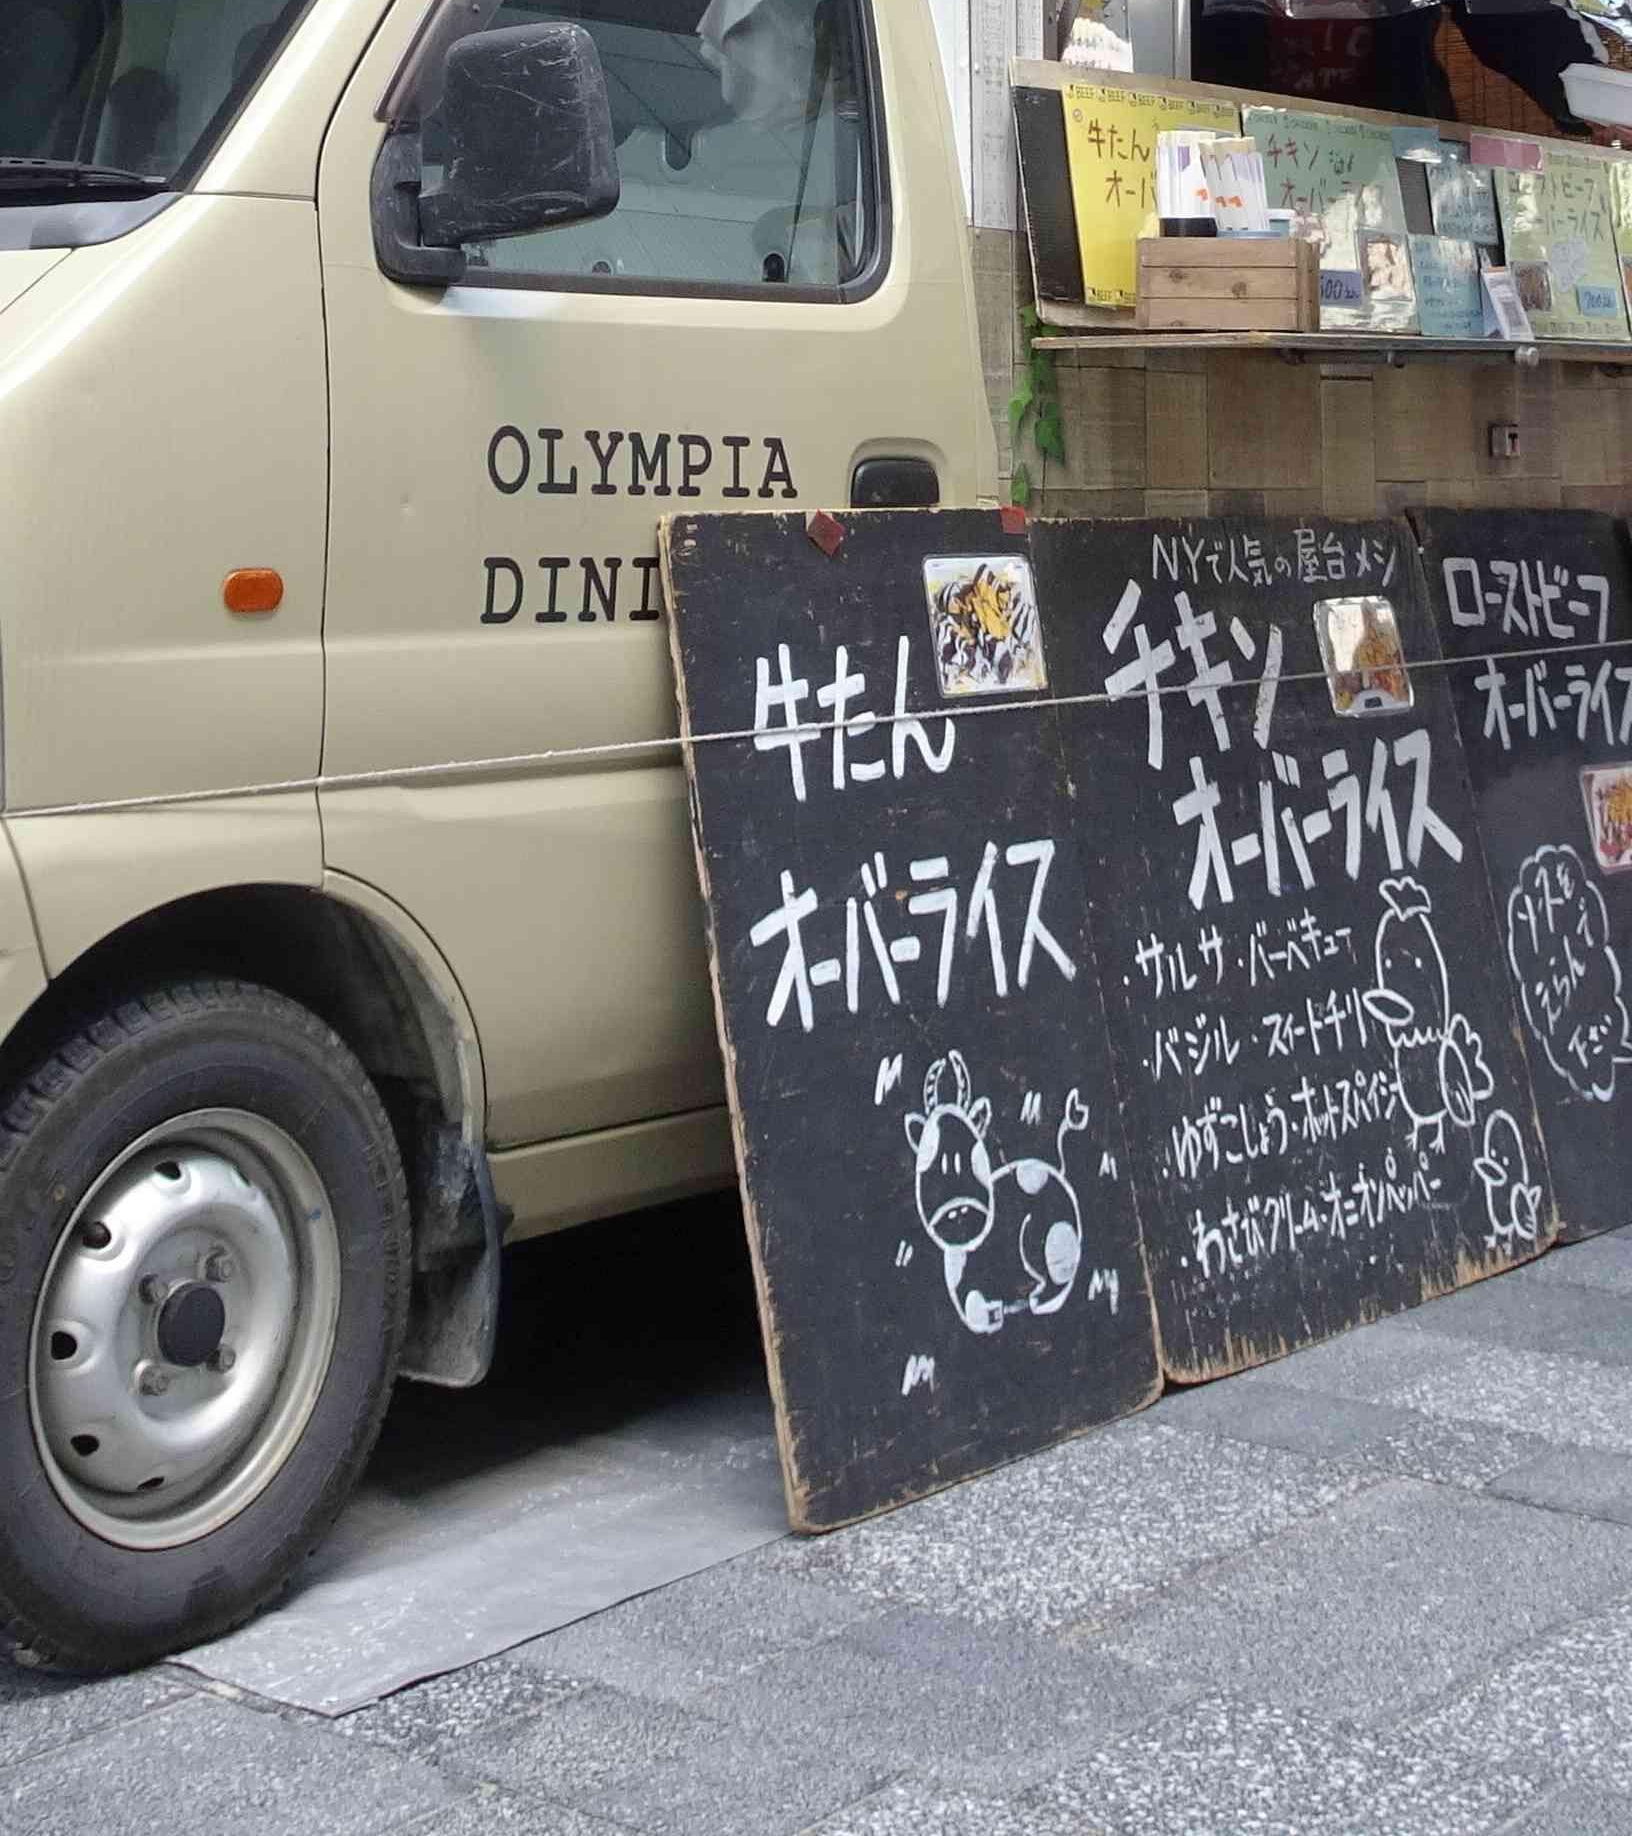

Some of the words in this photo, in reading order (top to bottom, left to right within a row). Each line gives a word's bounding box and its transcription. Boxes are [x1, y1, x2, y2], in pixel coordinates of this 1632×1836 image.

[1087, 118, 1151, 163] 牛たん
[1266, 133, 1320, 171] チキン
[486, 424, 798, 499] OLYMPIA
[1441, 556, 1609, 643] ローストビーフ
[753, 635, 957, 803] 牛たん
[1101, 578, 1283, 771] チキン
[1172, 728, 1464, 911] オーバーライス
[749, 839, 1077, 1033] オーバーライス
